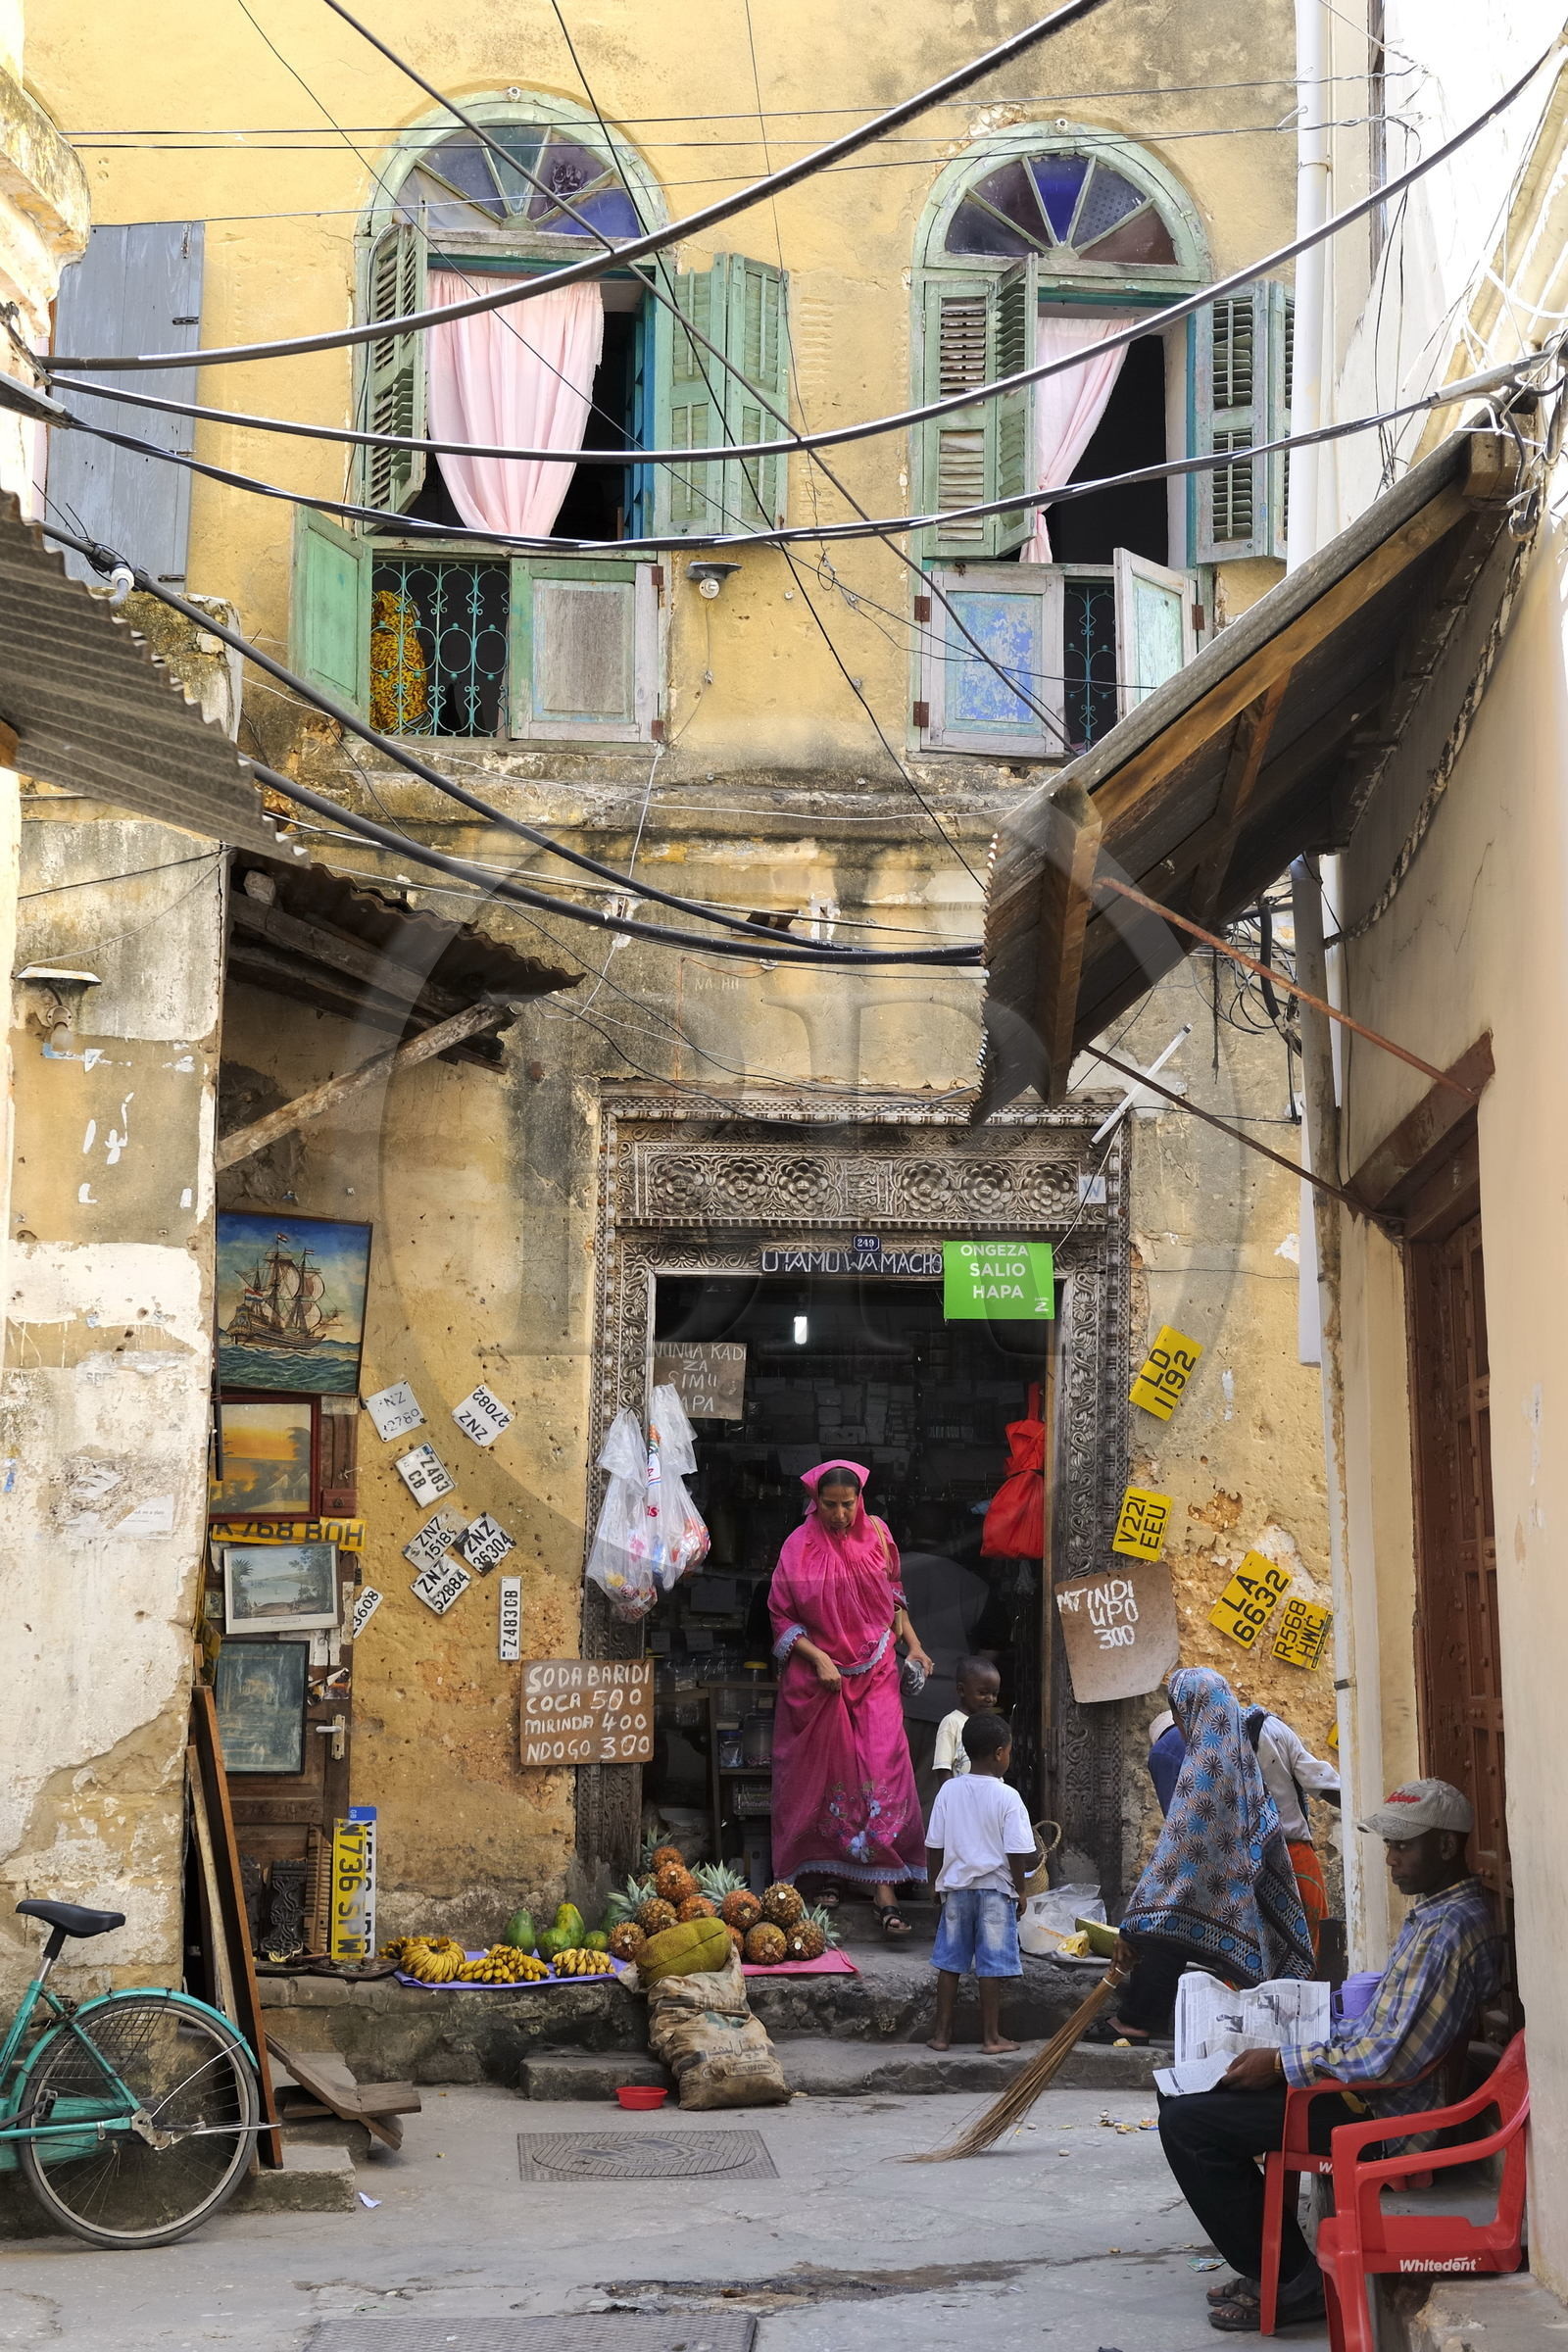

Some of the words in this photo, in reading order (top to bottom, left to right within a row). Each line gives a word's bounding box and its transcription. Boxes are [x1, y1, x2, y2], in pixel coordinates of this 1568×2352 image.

[857, 1238, 875, 1249] 249
[960, 1244, 1028, 1257] ONGEZA
[761, 1251, 840, 1272] UTAMU
[880, 1252, 943, 1274] MACHO
[969, 1262, 1026, 1277] SALIO
[973, 1284, 1024, 1299] HAPA
[683, 1359, 708, 1373] ZA
[710, 1343, 747, 1361] KADI
[668, 1370, 717, 1390] SIMU
[1140, 1348, 1170, 1387] LD
[1153, 1348, 1197, 1410] 1192
[471, 1388, 511, 1428] 27082
[682, 1395, 714, 1413] APA
[459, 1410, 489, 1441] ZNZ
[408, 1470, 426, 1490] CB
[1116, 1495, 1148, 1544] V221
[1140, 1505, 1169, 1549] EEU
[466, 1520, 496, 1554] ZNZ
[417, 1559, 450, 1594] ZNZ
[433, 1572, 469, 1610] 52884
[1221, 1574, 1257, 1614] LA
[1090, 1598, 1139, 1626] UPO
[1232, 1568, 1290, 1644] 6632
[1094, 1625, 1136, 1650] 300
[1274, 1599, 1307, 1658] R568
[525, 1665, 582, 1693] SODA
[588, 1663, 650, 1687] BARIDI
[526, 1692, 581, 1714] COCA
[591, 1688, 642, 1711] 500
[524, 1715, 594, 1736] MIRINDA
[602, 1712, 647, 1733] 400
[526, 1739, 591, 1763] NDOGO
[600, 1735, 650, 1759] 300
[1398, 2257, 1477, 2273] Whitedent
